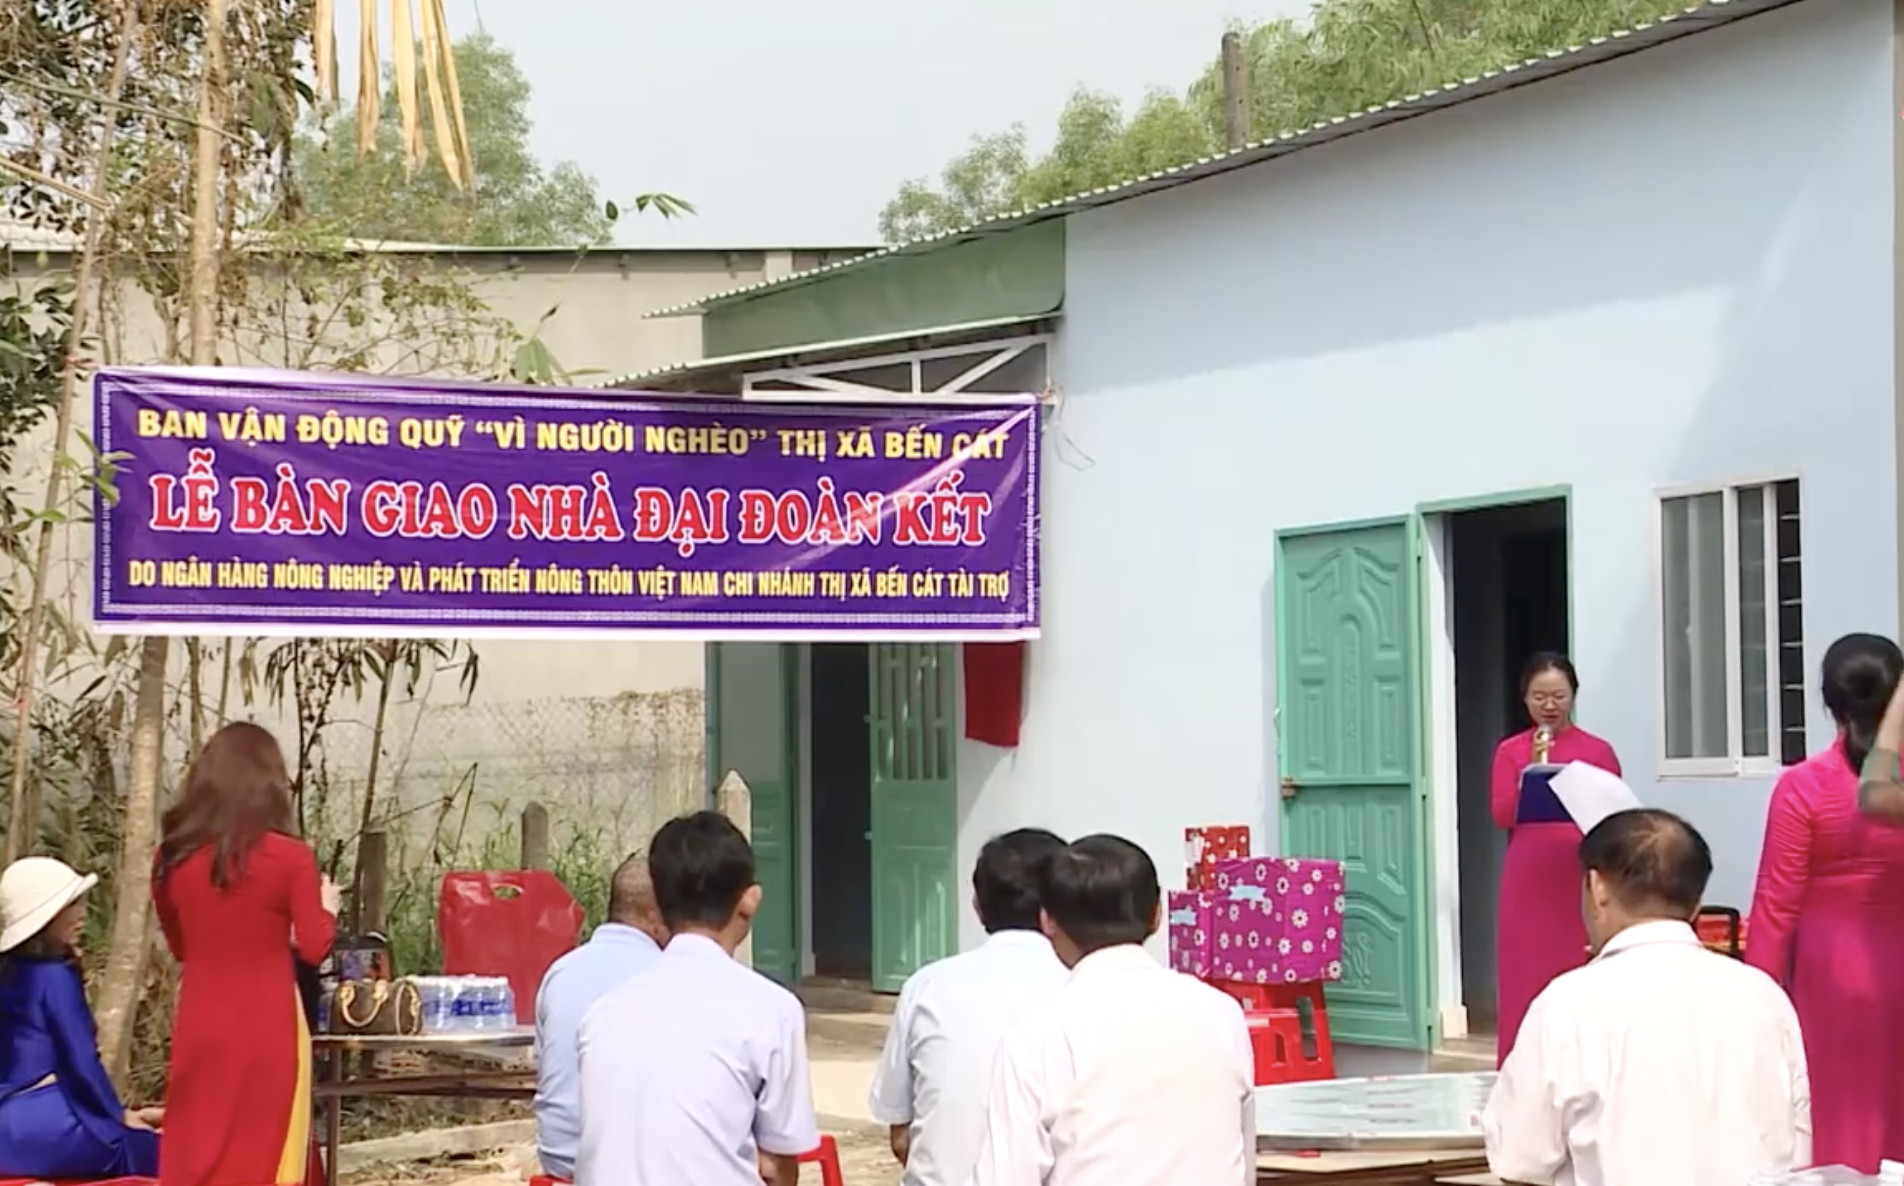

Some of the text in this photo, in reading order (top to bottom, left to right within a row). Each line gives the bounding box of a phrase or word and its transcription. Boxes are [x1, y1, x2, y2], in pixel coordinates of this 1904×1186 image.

[138, 406, 1009, 462] BAN VẬN ĐỘNG QUỸ “VÌ NGƯỜI NGHÈO” THỊ XÃ BẾN CÁT
[150, 448, 992, 557] LỄ BÀN GIAO NHÀ ĐẠI ĐOÀN KẾT
[128, 555, 1010, 602] DO NGÂN HÀNG NÔNG NGHIỆP VÀ PHÁT TRIỂN NÔNG THÔN VIỆT NAM CHI NHÁNH THỊ XÃ BẾN CÁT TÀI TRỢ
